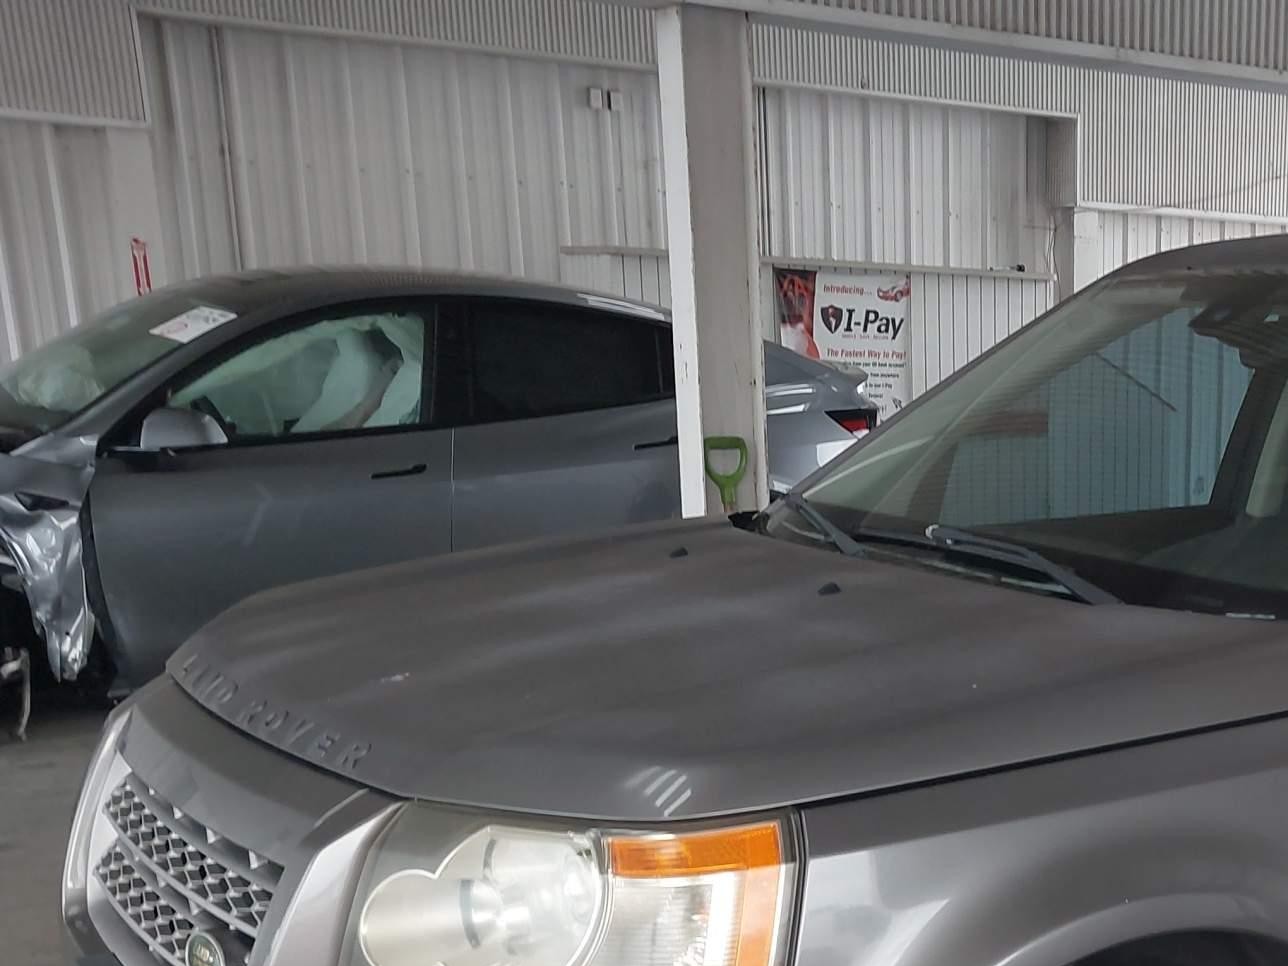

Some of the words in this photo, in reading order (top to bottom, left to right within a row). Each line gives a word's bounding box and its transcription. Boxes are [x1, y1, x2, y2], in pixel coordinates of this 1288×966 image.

[843, 307, 905, 341] I-Pay
[827, 347, 839, 358] The
[840, 348, 866, 359] Fastest
[867, 349, 882, 361] Way
[882, 350, 890, 359] to
[891, 350, 907, 361] Pay!
[238, 699, 373, 769] ROVER
